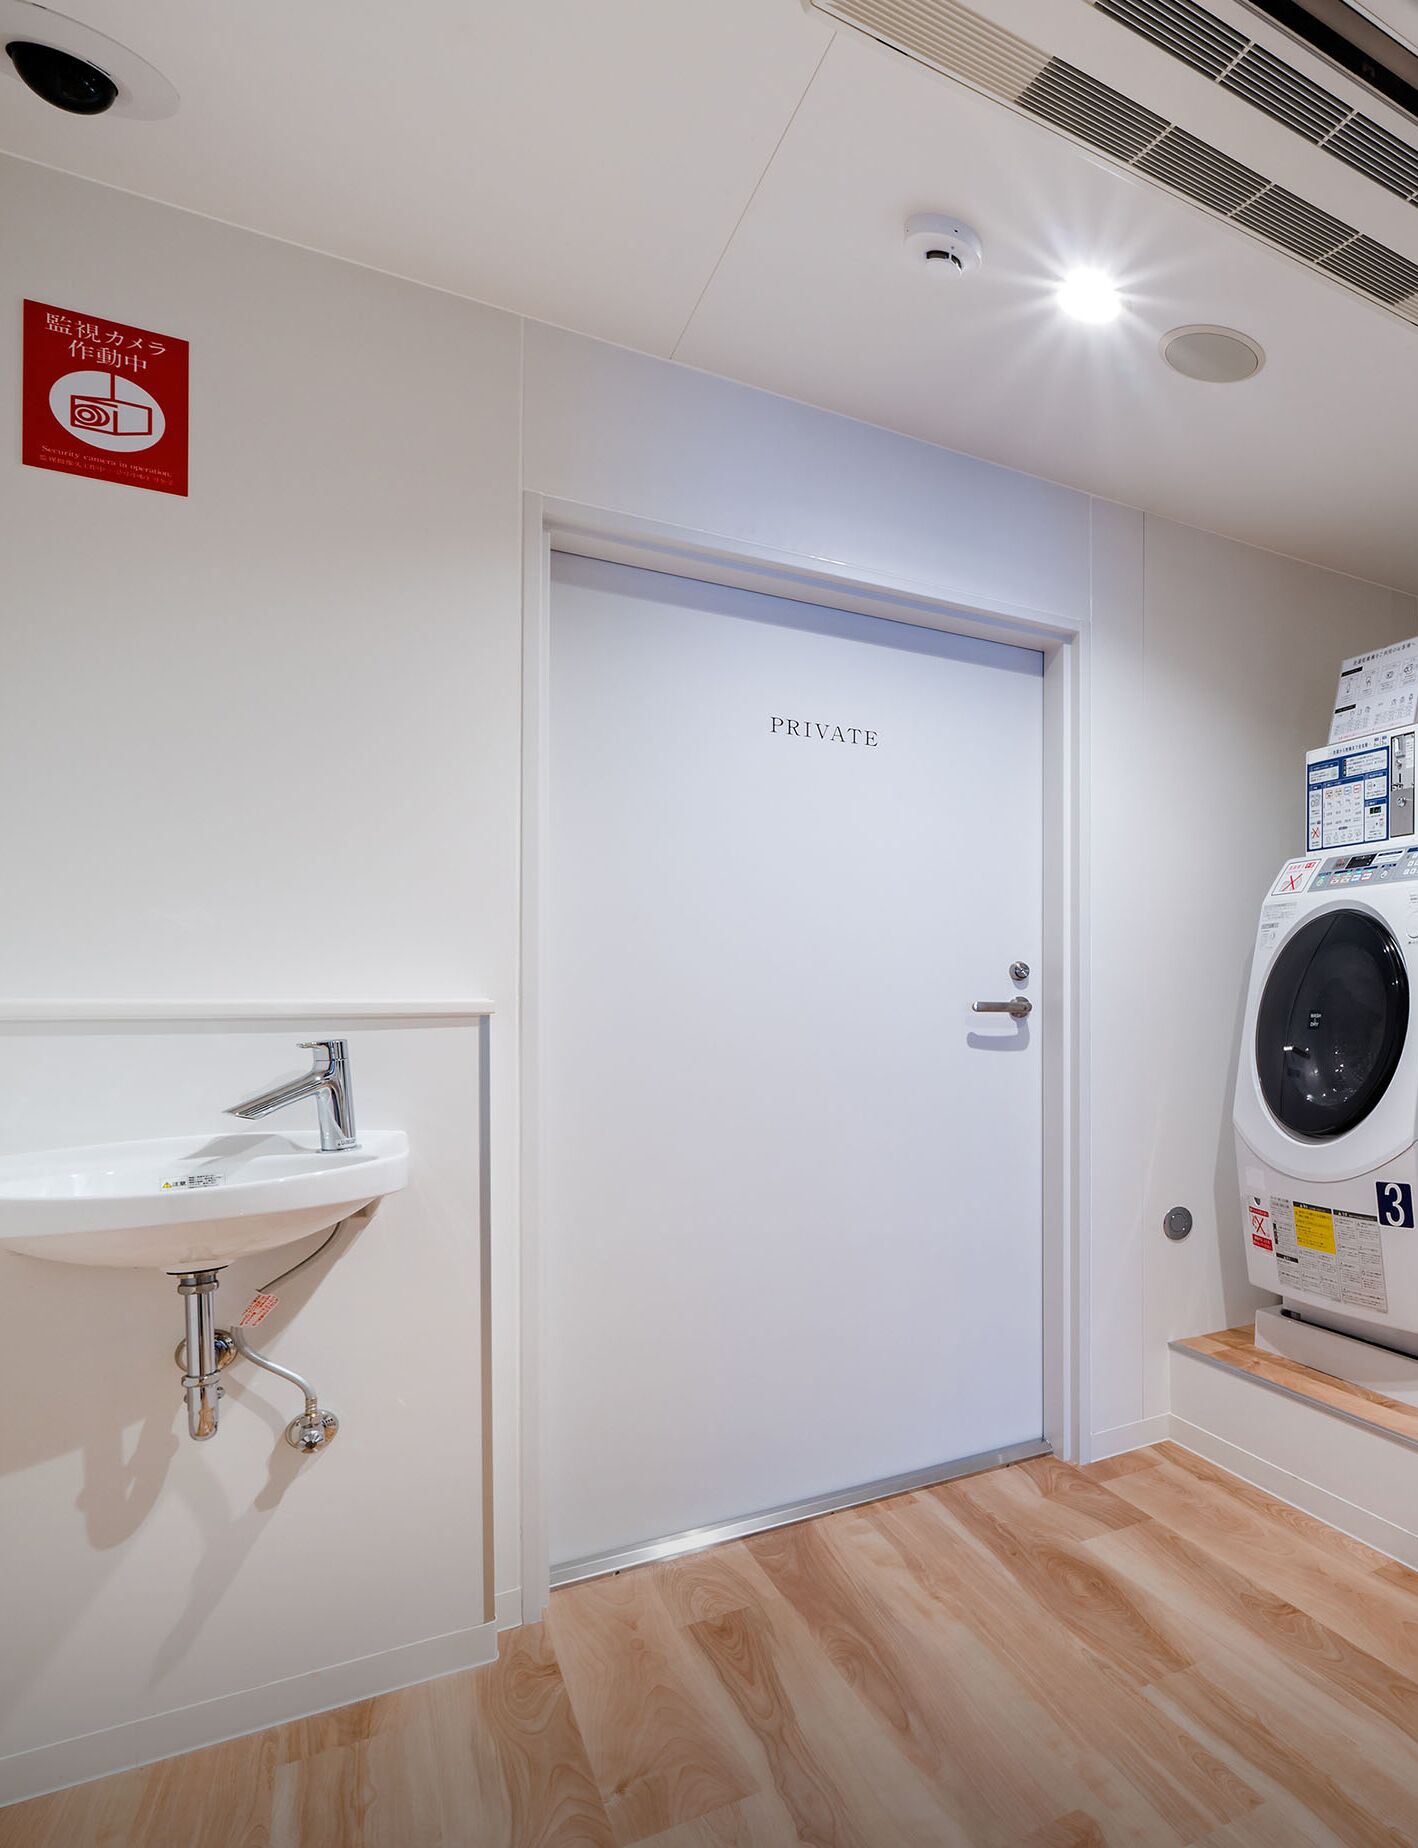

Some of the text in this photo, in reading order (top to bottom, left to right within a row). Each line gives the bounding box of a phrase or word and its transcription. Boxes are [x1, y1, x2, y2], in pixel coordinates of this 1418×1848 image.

[45, 312, 166, 356] 監視カメラ
[68, 339, 147, 373] 作動中
[41, 444, 80, 458] Security
[83, 454, 117, 466] camera
[119, 461, 128, 469] in
[770, 716, 878, 747] PRIVATE
[1384, 1183, 1405, 1227] 3
